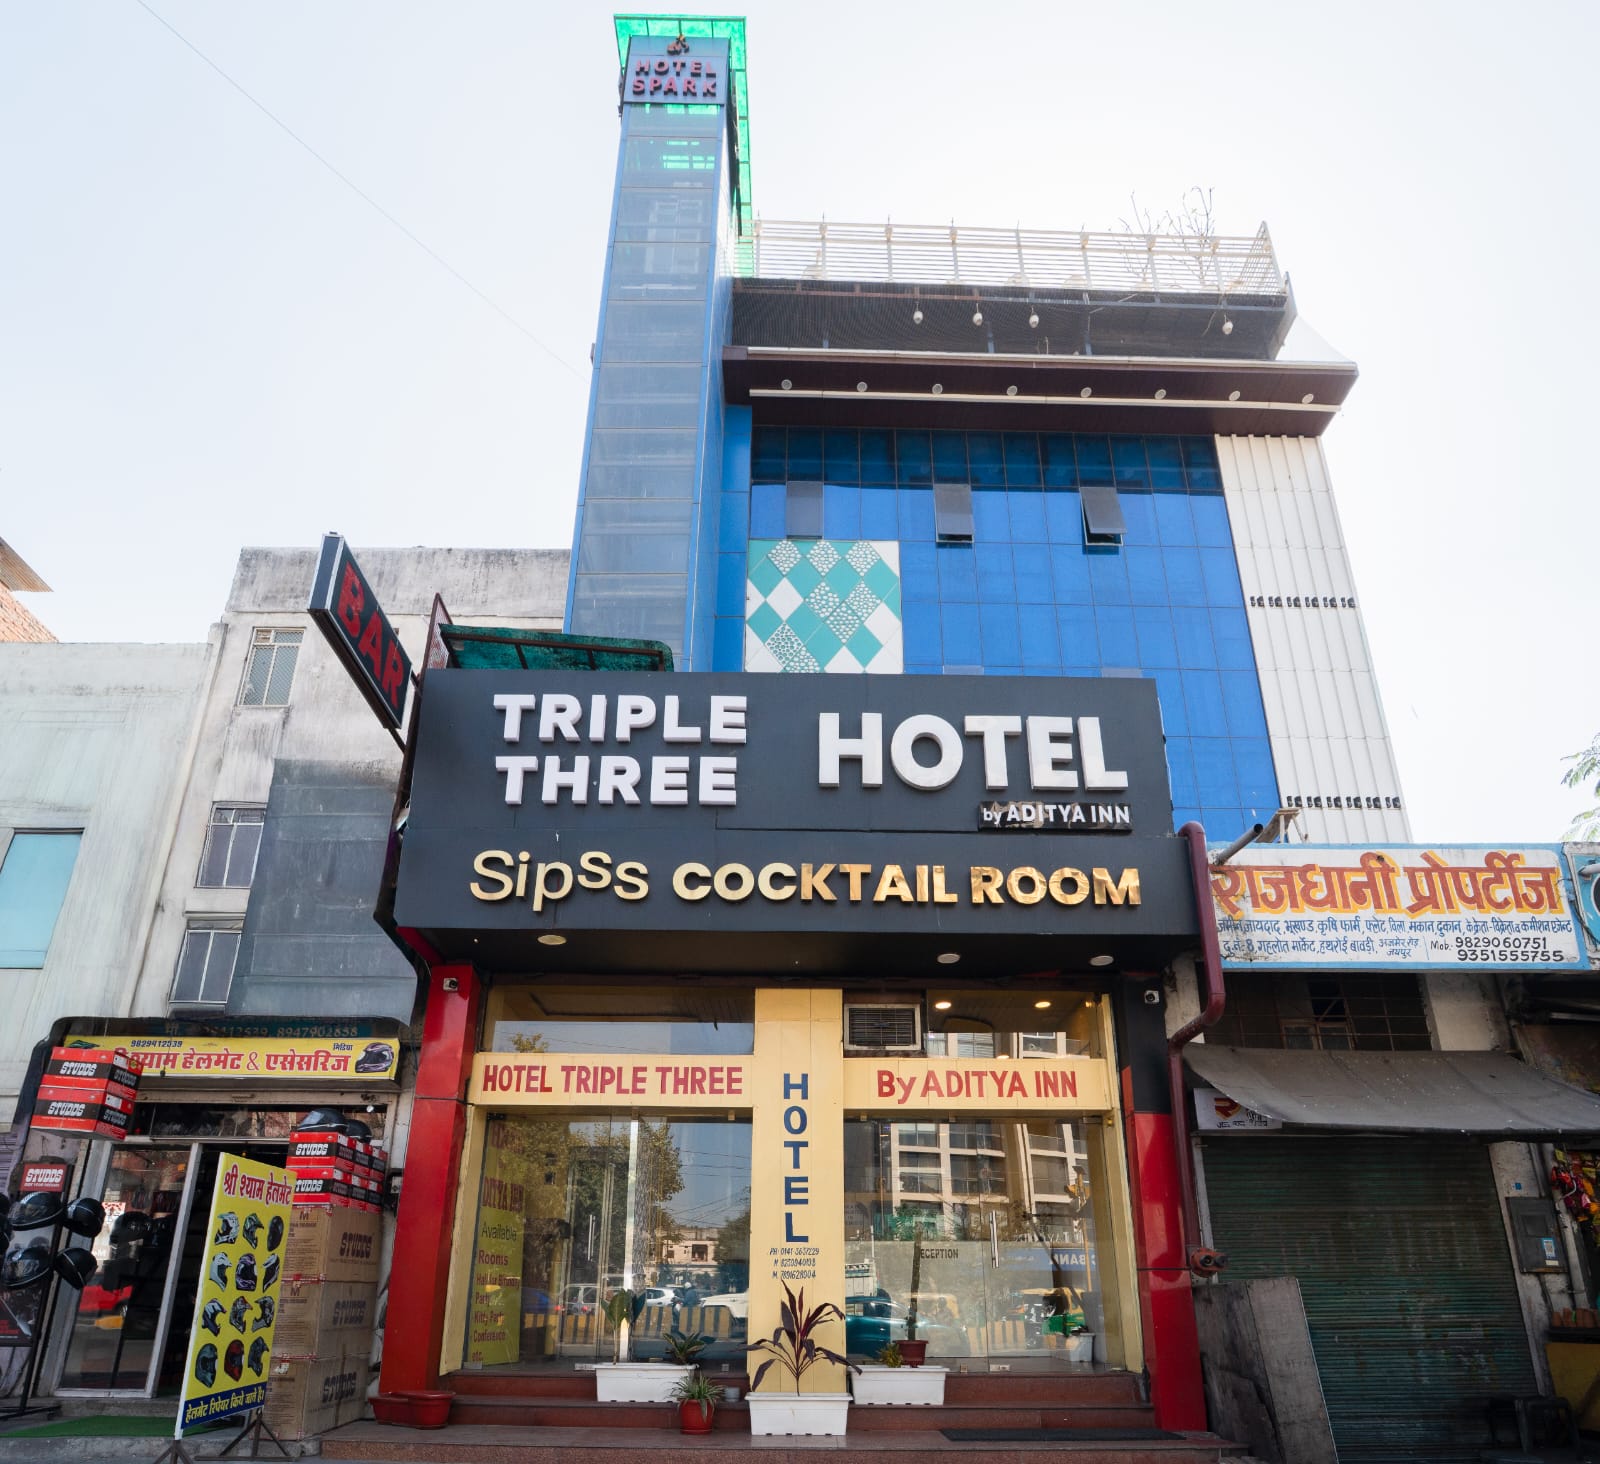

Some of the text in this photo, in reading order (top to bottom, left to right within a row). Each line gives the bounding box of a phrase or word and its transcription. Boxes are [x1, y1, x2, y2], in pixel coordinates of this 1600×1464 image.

[635, 59, 717, 78] HOTEL
[632, 77, 717, 97] SPARK
[336, 561, 406, 710] BAR
[493, 693, 748, 744] TRIPLE
[817, 711, 1129, 792] HOTEL
[495, 755, 738, 806] THREE
[982, 803, 1130, 827] by ADITYA INN
[970, 864, 1142, 907] ROOM
[1209, 850, 1401, 918] राजधानी
[1457, 949, 1565, 962] 9351555755
[59, 1061, 98, 1076] STUDDS
[183, 1047, 245, 1071] हेलमेट
[246, 1051, 260, 1071] &
[483, 1065, 743, 1096] HOTEL TRIPLE THREE
[876, 1069, 1077, 1105] By ADITYA INN
[47, 1101, 86, 1117] STUDDS
[295, 1143, 329, 1156] STUDDS
[783, 1072, 810, 1243] HOTEL
[25, 1168, 64, 1183] STUDDS
[223, 1164, 293, 1206] श्री श्याम हेलमेट
[295, 1179, 324, 1192] TUDDS
[339, 1231, 373, 1259] STUDDS
[481, 1223, 517, 1242] Available
[477, 1249, 509, 1266] Rooms
[919, 1248, 960, 1259] ECEPTION
[332, 1299, 367, 1326] STUDDS
[321, 1371, 357, 1404] STUDDS
